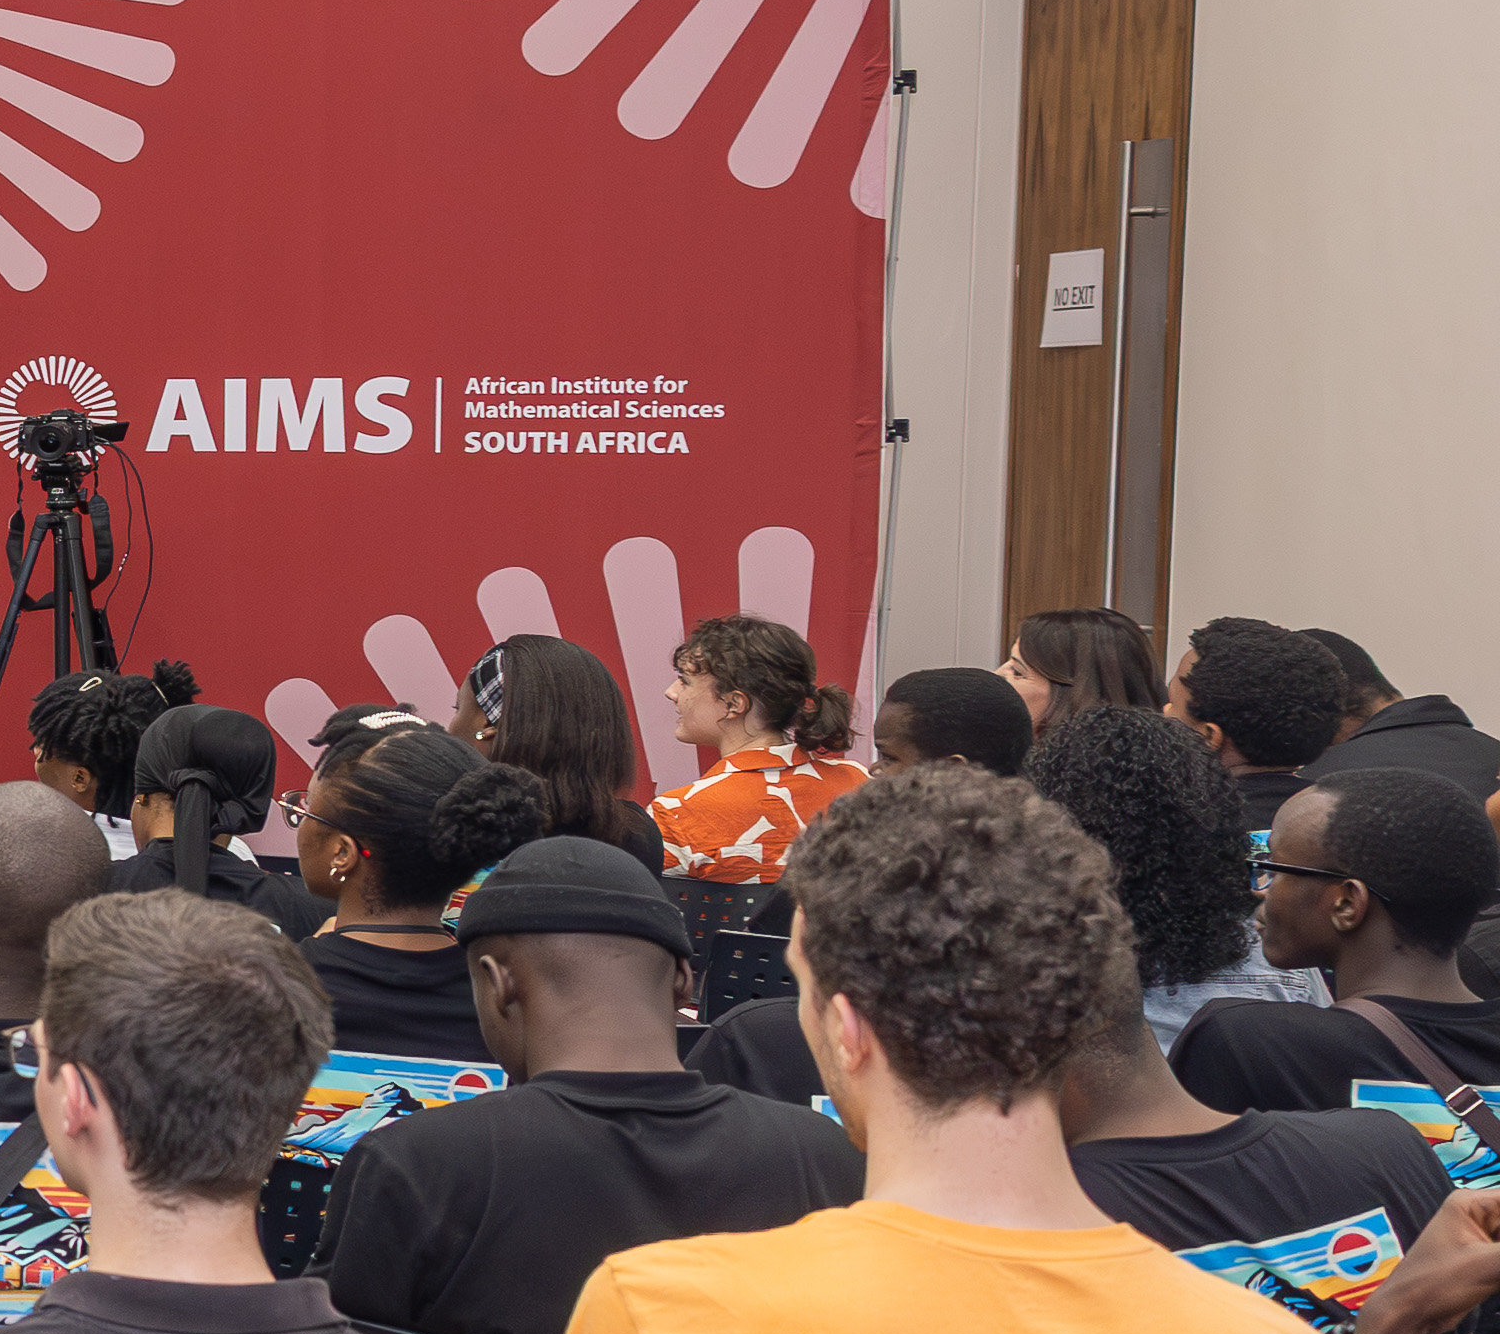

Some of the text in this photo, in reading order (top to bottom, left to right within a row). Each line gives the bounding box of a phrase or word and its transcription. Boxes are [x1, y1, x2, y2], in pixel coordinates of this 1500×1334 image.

[1053, 285, 1095, 306] NO EXIT
[464, 374, 689, 395] African Institute for
[145, 376, 413, 454] AIMS
[464, 399, 725, 419] Mathematical Sciences
[463, 431, 690, 454] SOUTH AFRICA
